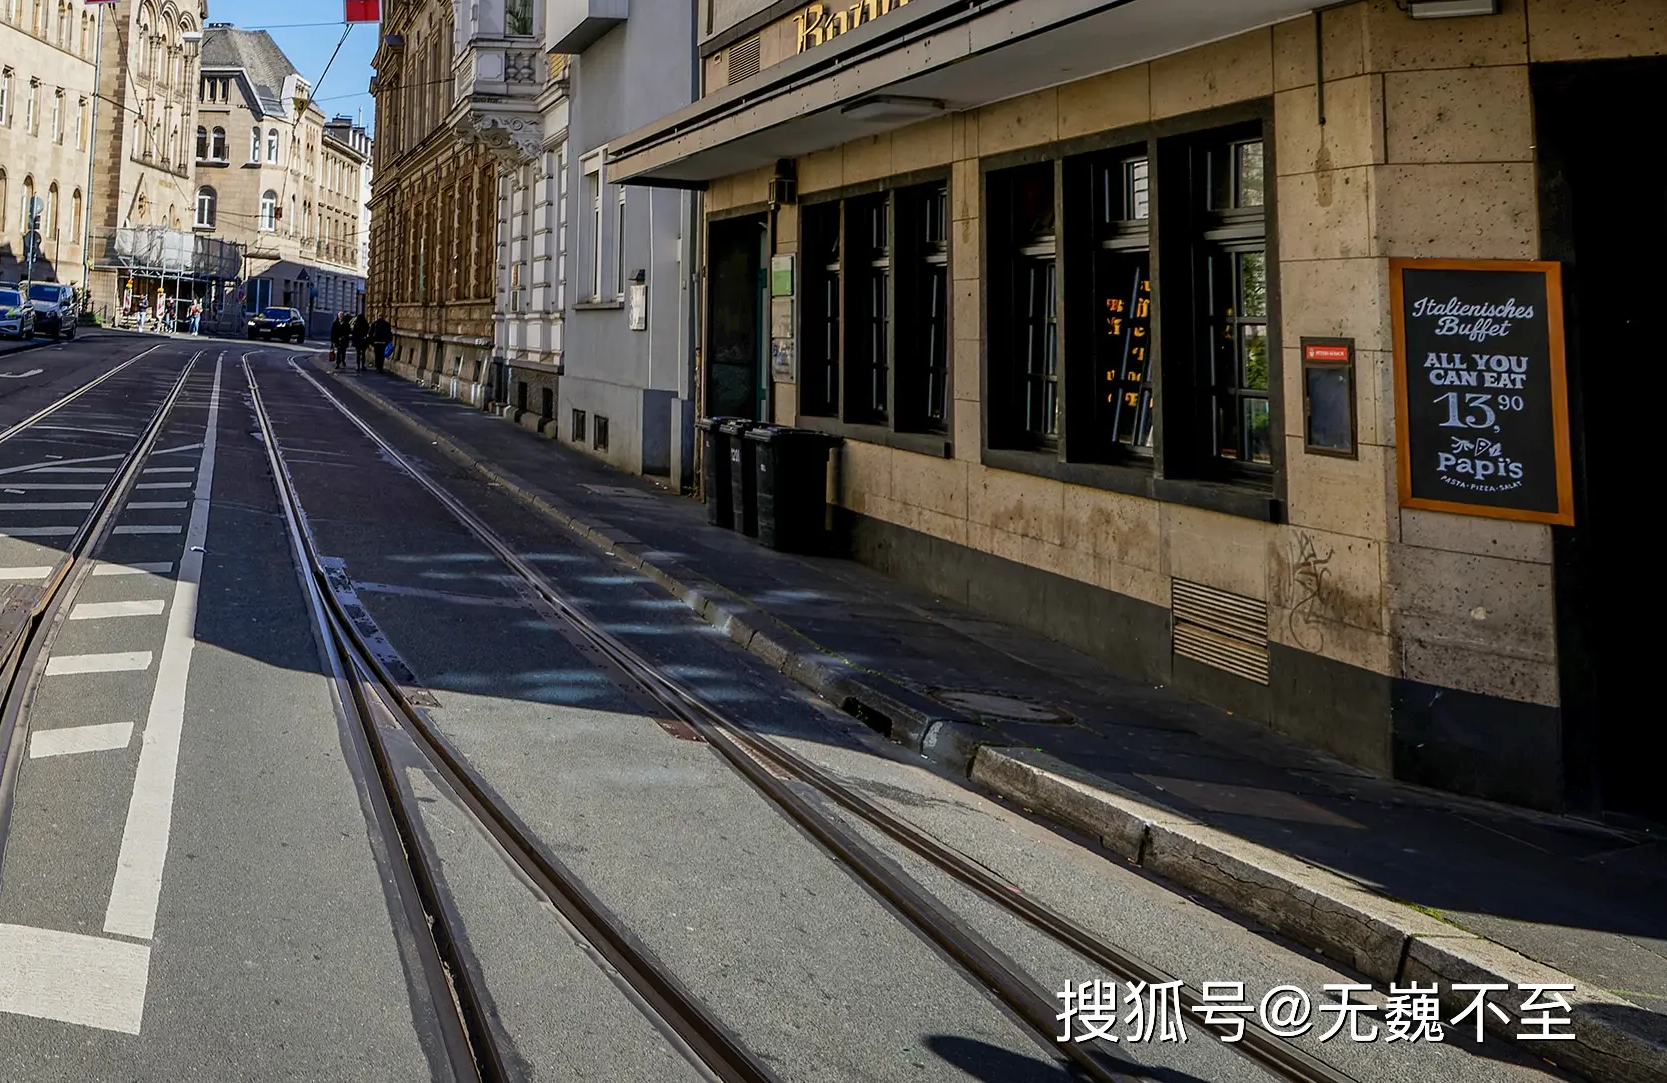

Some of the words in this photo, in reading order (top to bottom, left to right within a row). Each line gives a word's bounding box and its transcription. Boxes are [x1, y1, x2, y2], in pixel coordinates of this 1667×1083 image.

[298, 100, 304, 111] 3
[1412, 296, 1534, 319] Italienisches
[1434, 316, 1512, 343] Buffet
[1423, 352, 1467, 369] ALL
[1471, 354, 1529, 373] YOU
[1429, 369, 1478, 386] CAN
[1482, 372, 1526, 389] EAT
[1436, 451, 1524, 481] Papi's
